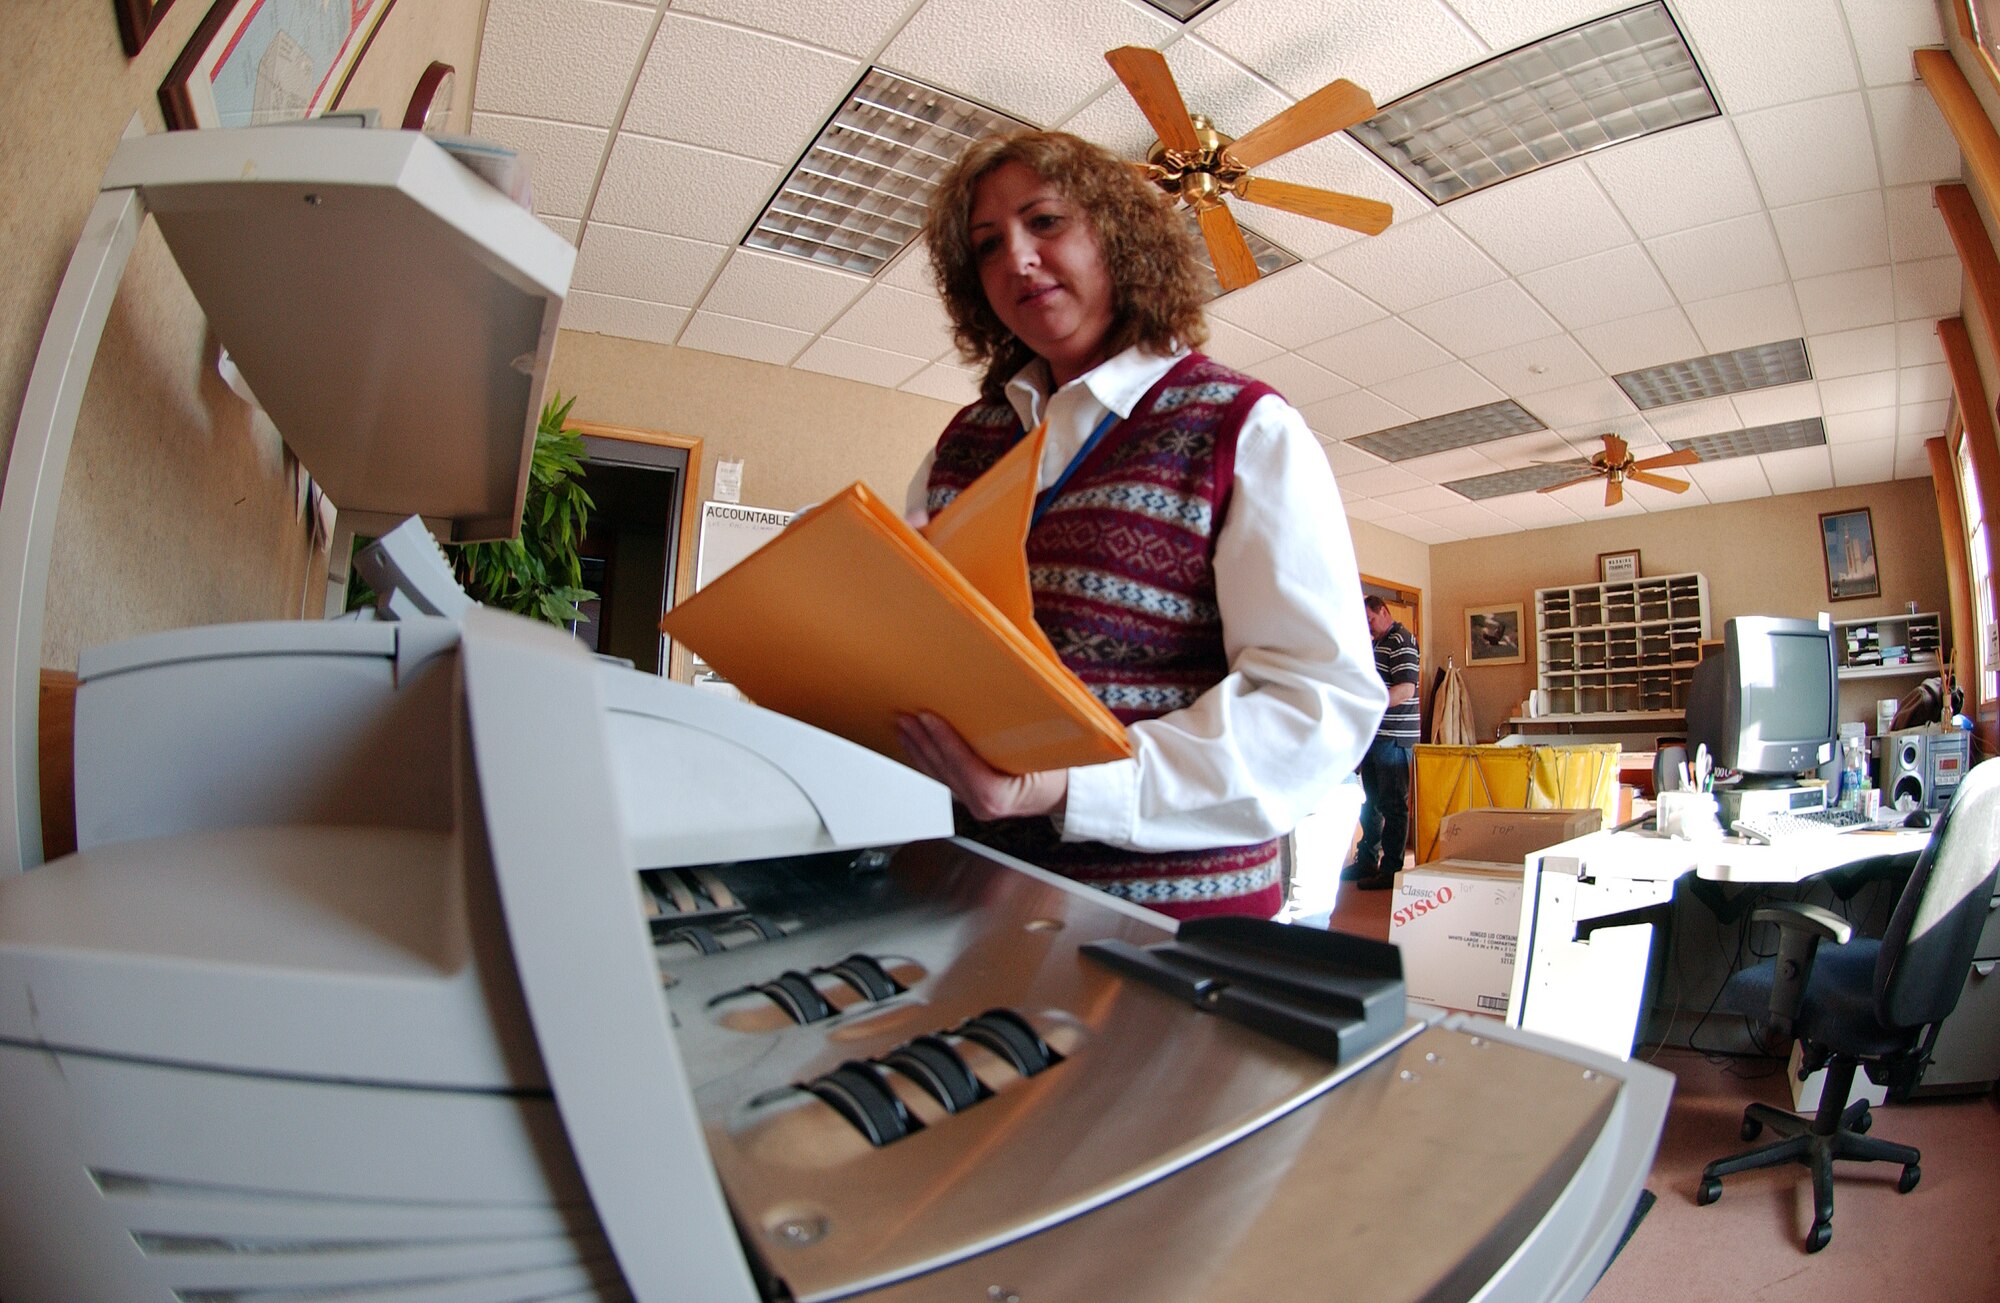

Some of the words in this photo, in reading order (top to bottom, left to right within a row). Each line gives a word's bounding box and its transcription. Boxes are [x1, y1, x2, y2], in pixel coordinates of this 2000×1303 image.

[706, 506, 790, 527] ACCOUNTABLE
[1401, 884, 1433, 898] Classic
[1393, 886, 1453, 928] SYSCO
